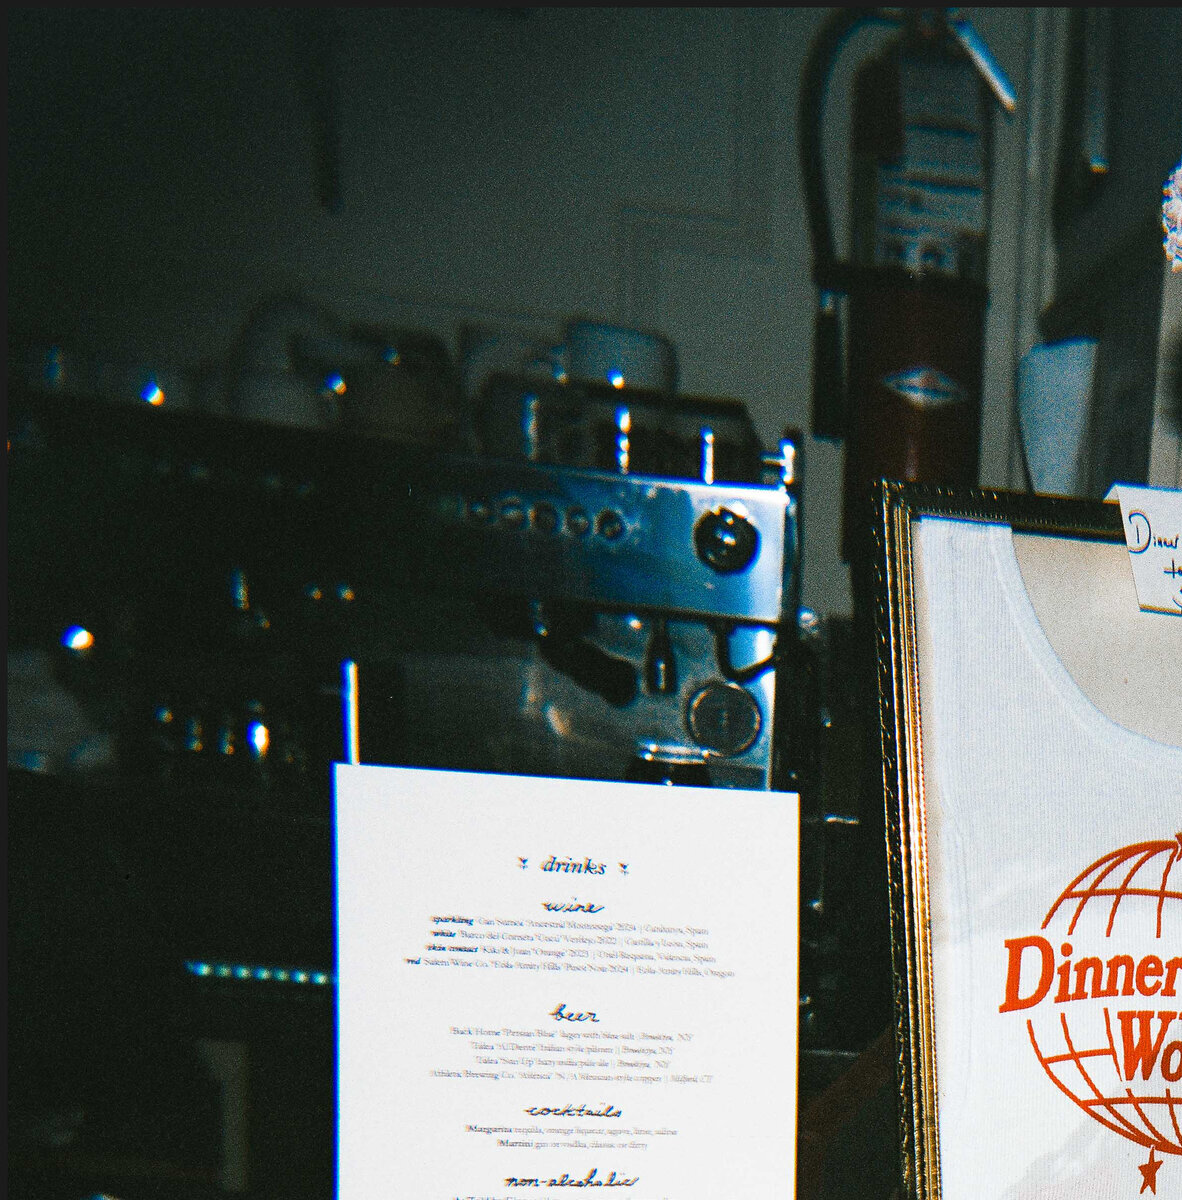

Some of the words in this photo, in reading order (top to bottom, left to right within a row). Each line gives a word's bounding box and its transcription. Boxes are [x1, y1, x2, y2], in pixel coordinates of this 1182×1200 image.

[542, 855, 607, 876] drinks
[541, 897, 605, 915] wine
[430, 915, 474, 926] sparkling
[686, 925, 709, 936] Spain
[430, 929, 457, 938] white
[596, 935, 617, 945] 2022
[686, 939, 709, 951] Spain
[451, 959, 473, 968] Wine
[502, 946, 510, 955] &
[511, 947, 532, 957] Juan
[693, 954, 717, 965] Spain
[548, 1003, 600, 1023] beer
[474, 1027, 501, 1038] Home
[523, 1102, 623, 1118] cocktails
[465, 1124, 513, 1135] Margarita
[497, 1139, 534, 1149] Martini
[504, 1167, 640, 1188] non-alcoholic
